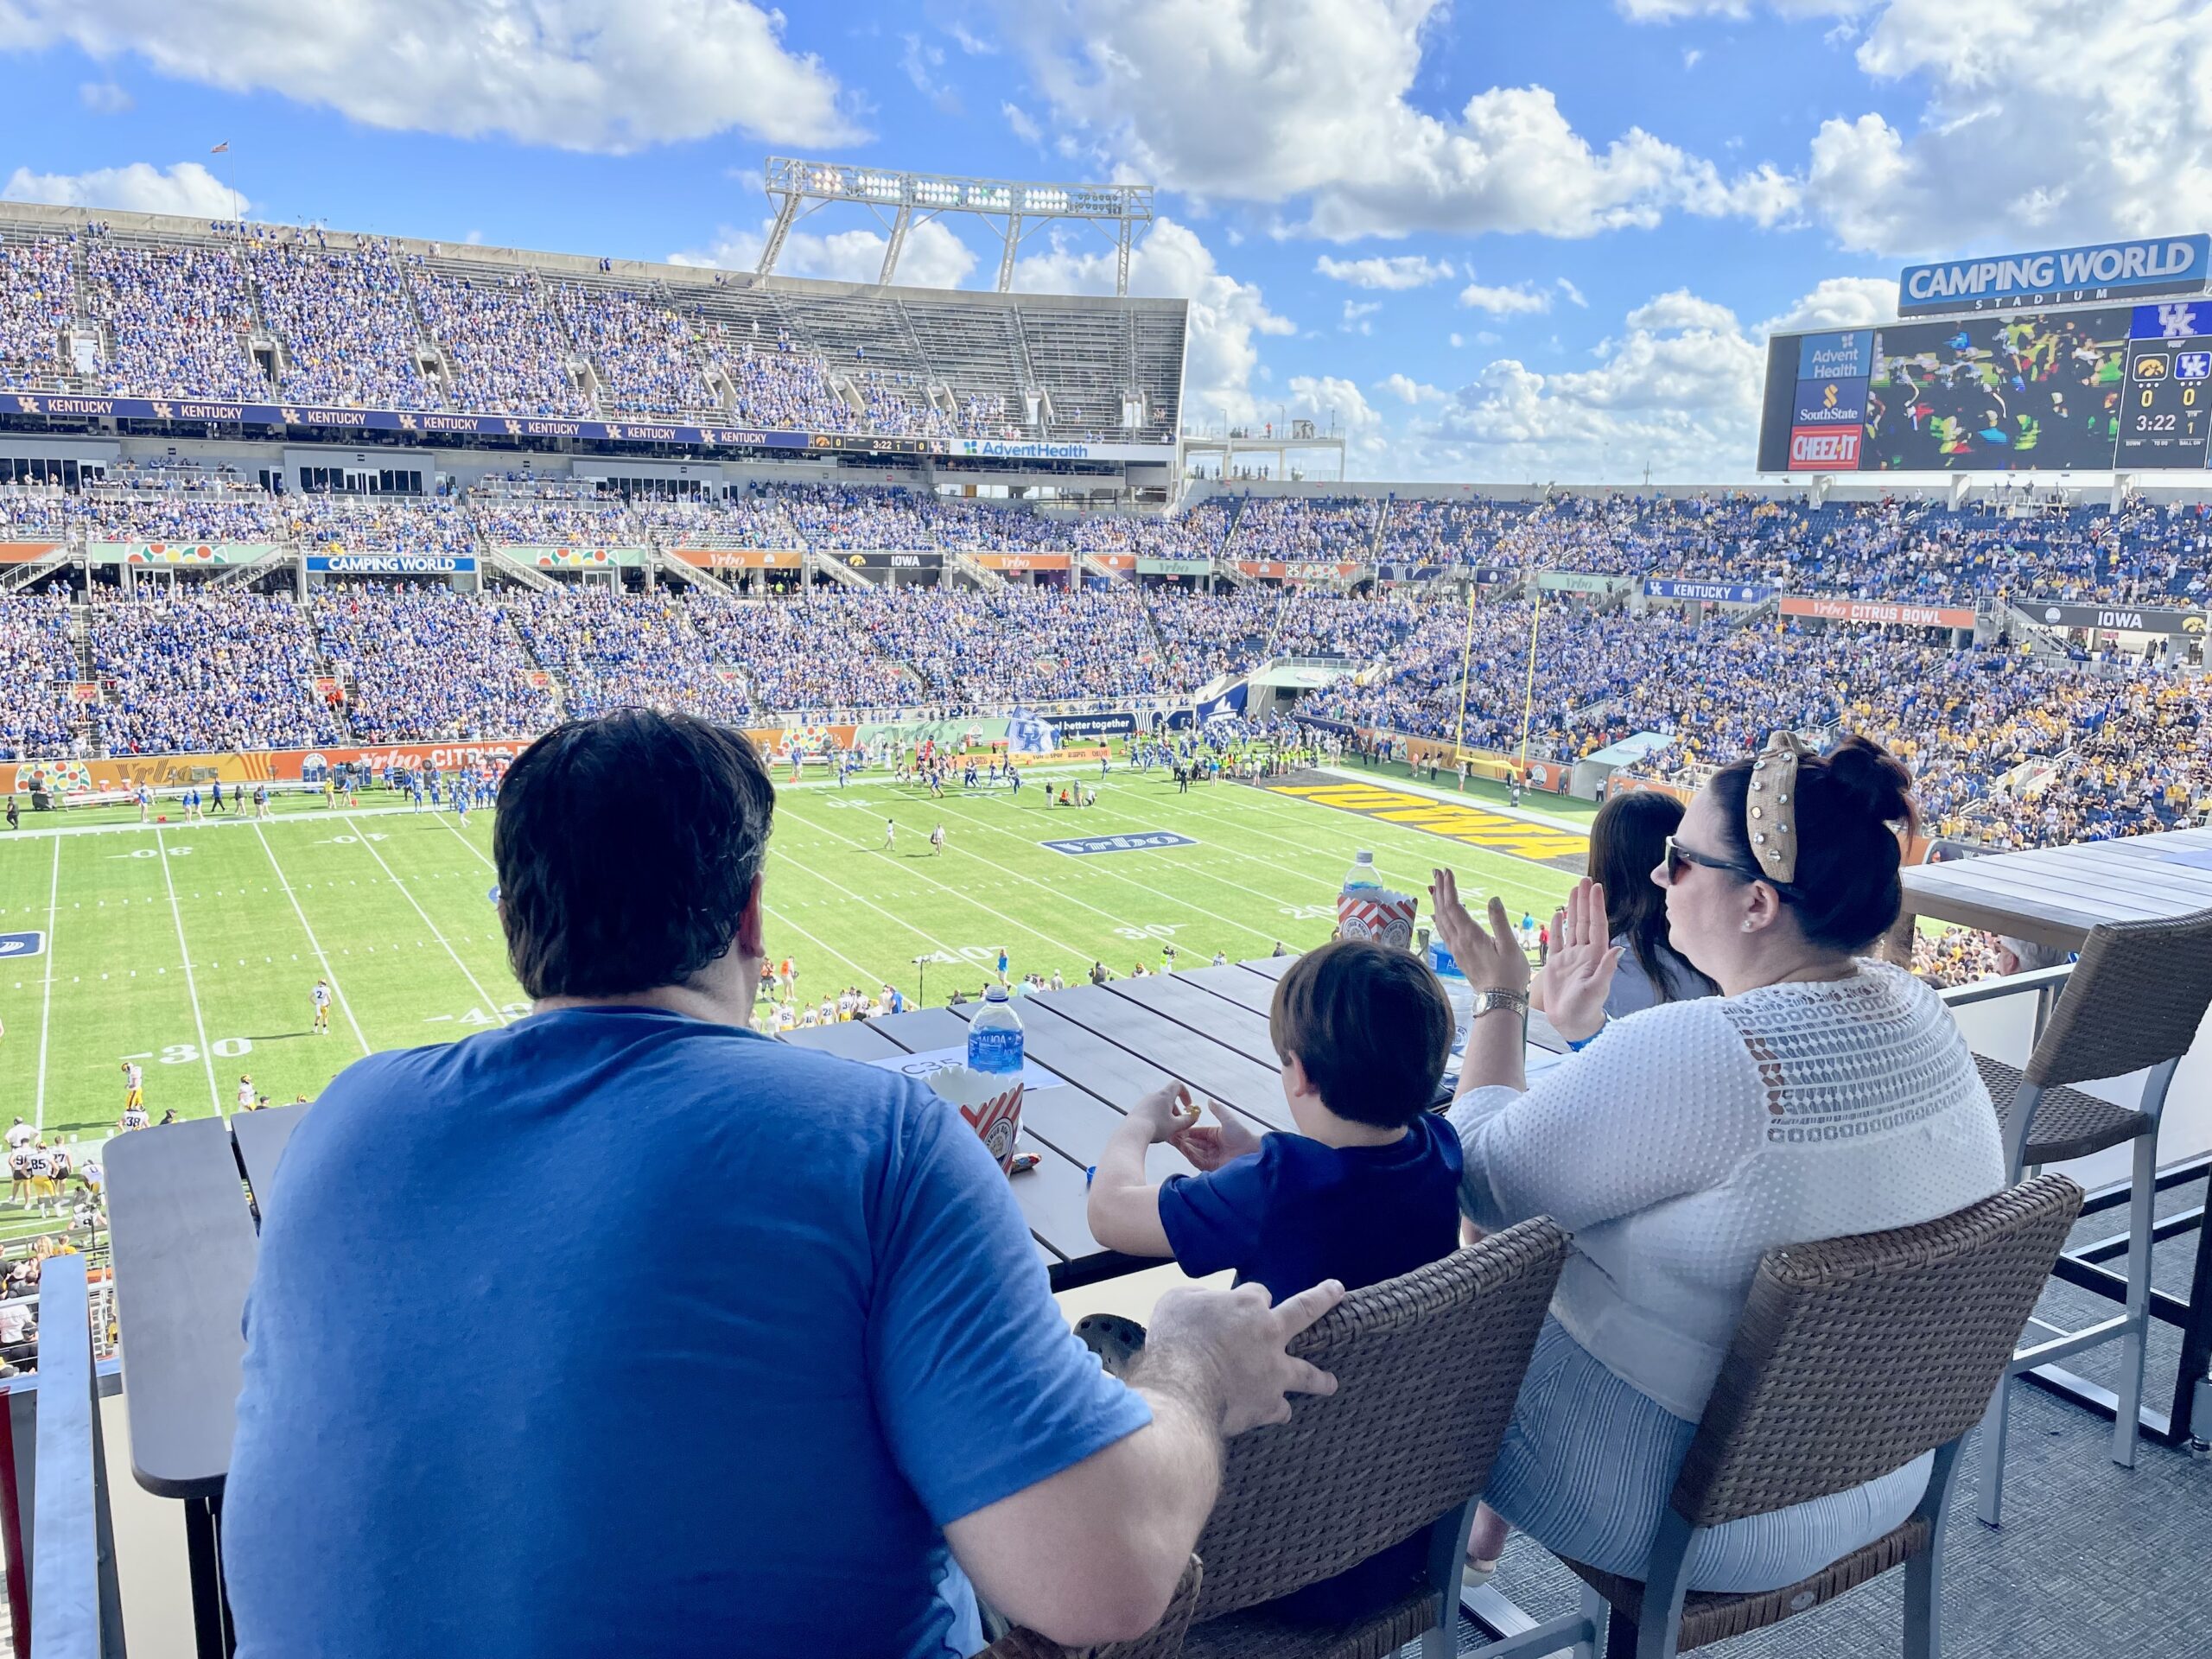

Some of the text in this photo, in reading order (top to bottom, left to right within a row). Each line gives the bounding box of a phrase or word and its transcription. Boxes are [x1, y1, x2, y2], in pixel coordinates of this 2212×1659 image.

[1909, 243, 2195, 300] CAMPING WORLD
[1975, 288, 2108, 309] STADIUM
[1812, 348, 1859, 363] Advent
[1815, 364, 1857, 378] Health
[2141, 390, 2152, 407] 0
[2183, 389, 2195, 406] 0
[48, 399, 113, 414] KENTUCKY
[181, 405, 243, 419] KENTUCKY
[308, 411, 365, 425] KENTUCKY
[1800, 408, 1858, 421] SouthState
[423, 416, 478, 430] KENTUCKY
[528, 422, 579, 435] KENTUCKY
[2136, 415, 2176, 431] 3:22
[2188, 423, 2194, 434] 1
[627, 427, 676, 440] KENTUCKY
[721, 431, 766, 443] KENTUCKY
[873, 441, 892, 449] 3:22
[982, 442, 1088, 458] AdventHealth
[328, 558, 455, 570] CAMPING WORLD
[709, 554, 745, 566] Vrbo
[891, 556, 920, 566] IOWA
[1001, 556, 1030, 568] Vrbo
[1287, 566, 1299, 575] 25
[1673, 584, 1732, 600] KENTUCKY
[1815, 602, 1941, 624] Vrbo CITRUS BOWL
[2098, 611, 2142, 628] IOWA
[1092, 719, 1129, 730] together
[359, 750, 422, 770] Vrbo
[1264, 783, 1590, 860] IOWA
[1052, 836, 1179, 852] Vrbo
[317, 990, 323, 999] 2
[901, 1058, 963, 1074] C35
[31, 1159, 46, 1169] 85
